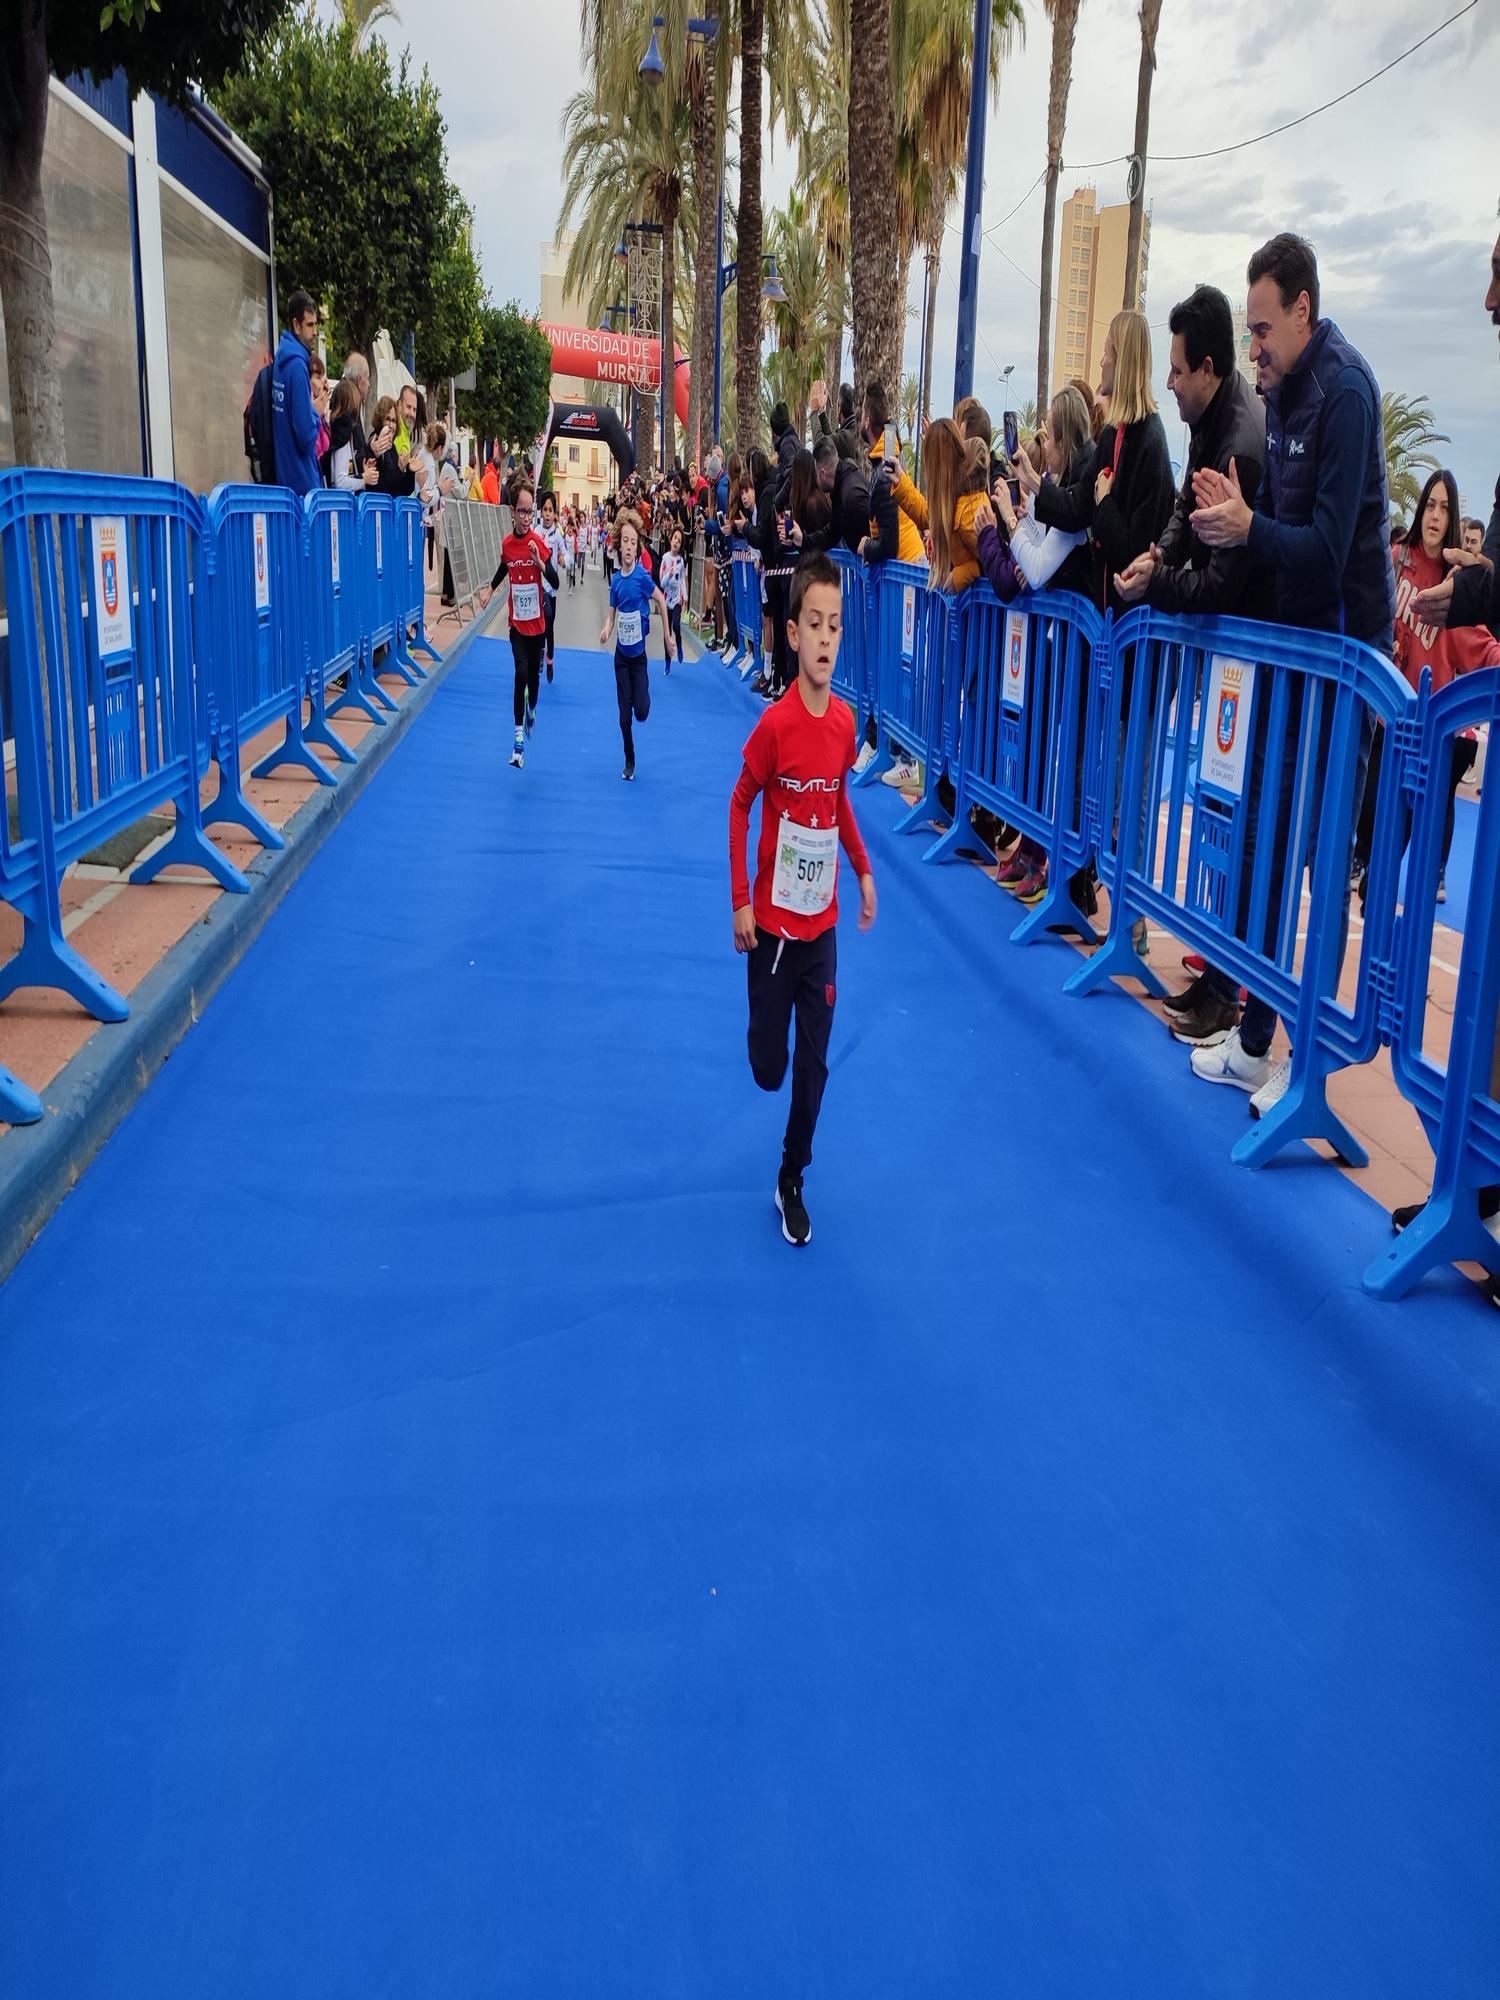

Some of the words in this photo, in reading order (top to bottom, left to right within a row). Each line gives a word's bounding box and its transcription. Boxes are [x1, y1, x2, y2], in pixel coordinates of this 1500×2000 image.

[633, 341, 650, 359] DE
[597, 361, 649, 382] MURCIA
[519, 597, 532, 608] 527
[797, 858, 825, 883] 507
